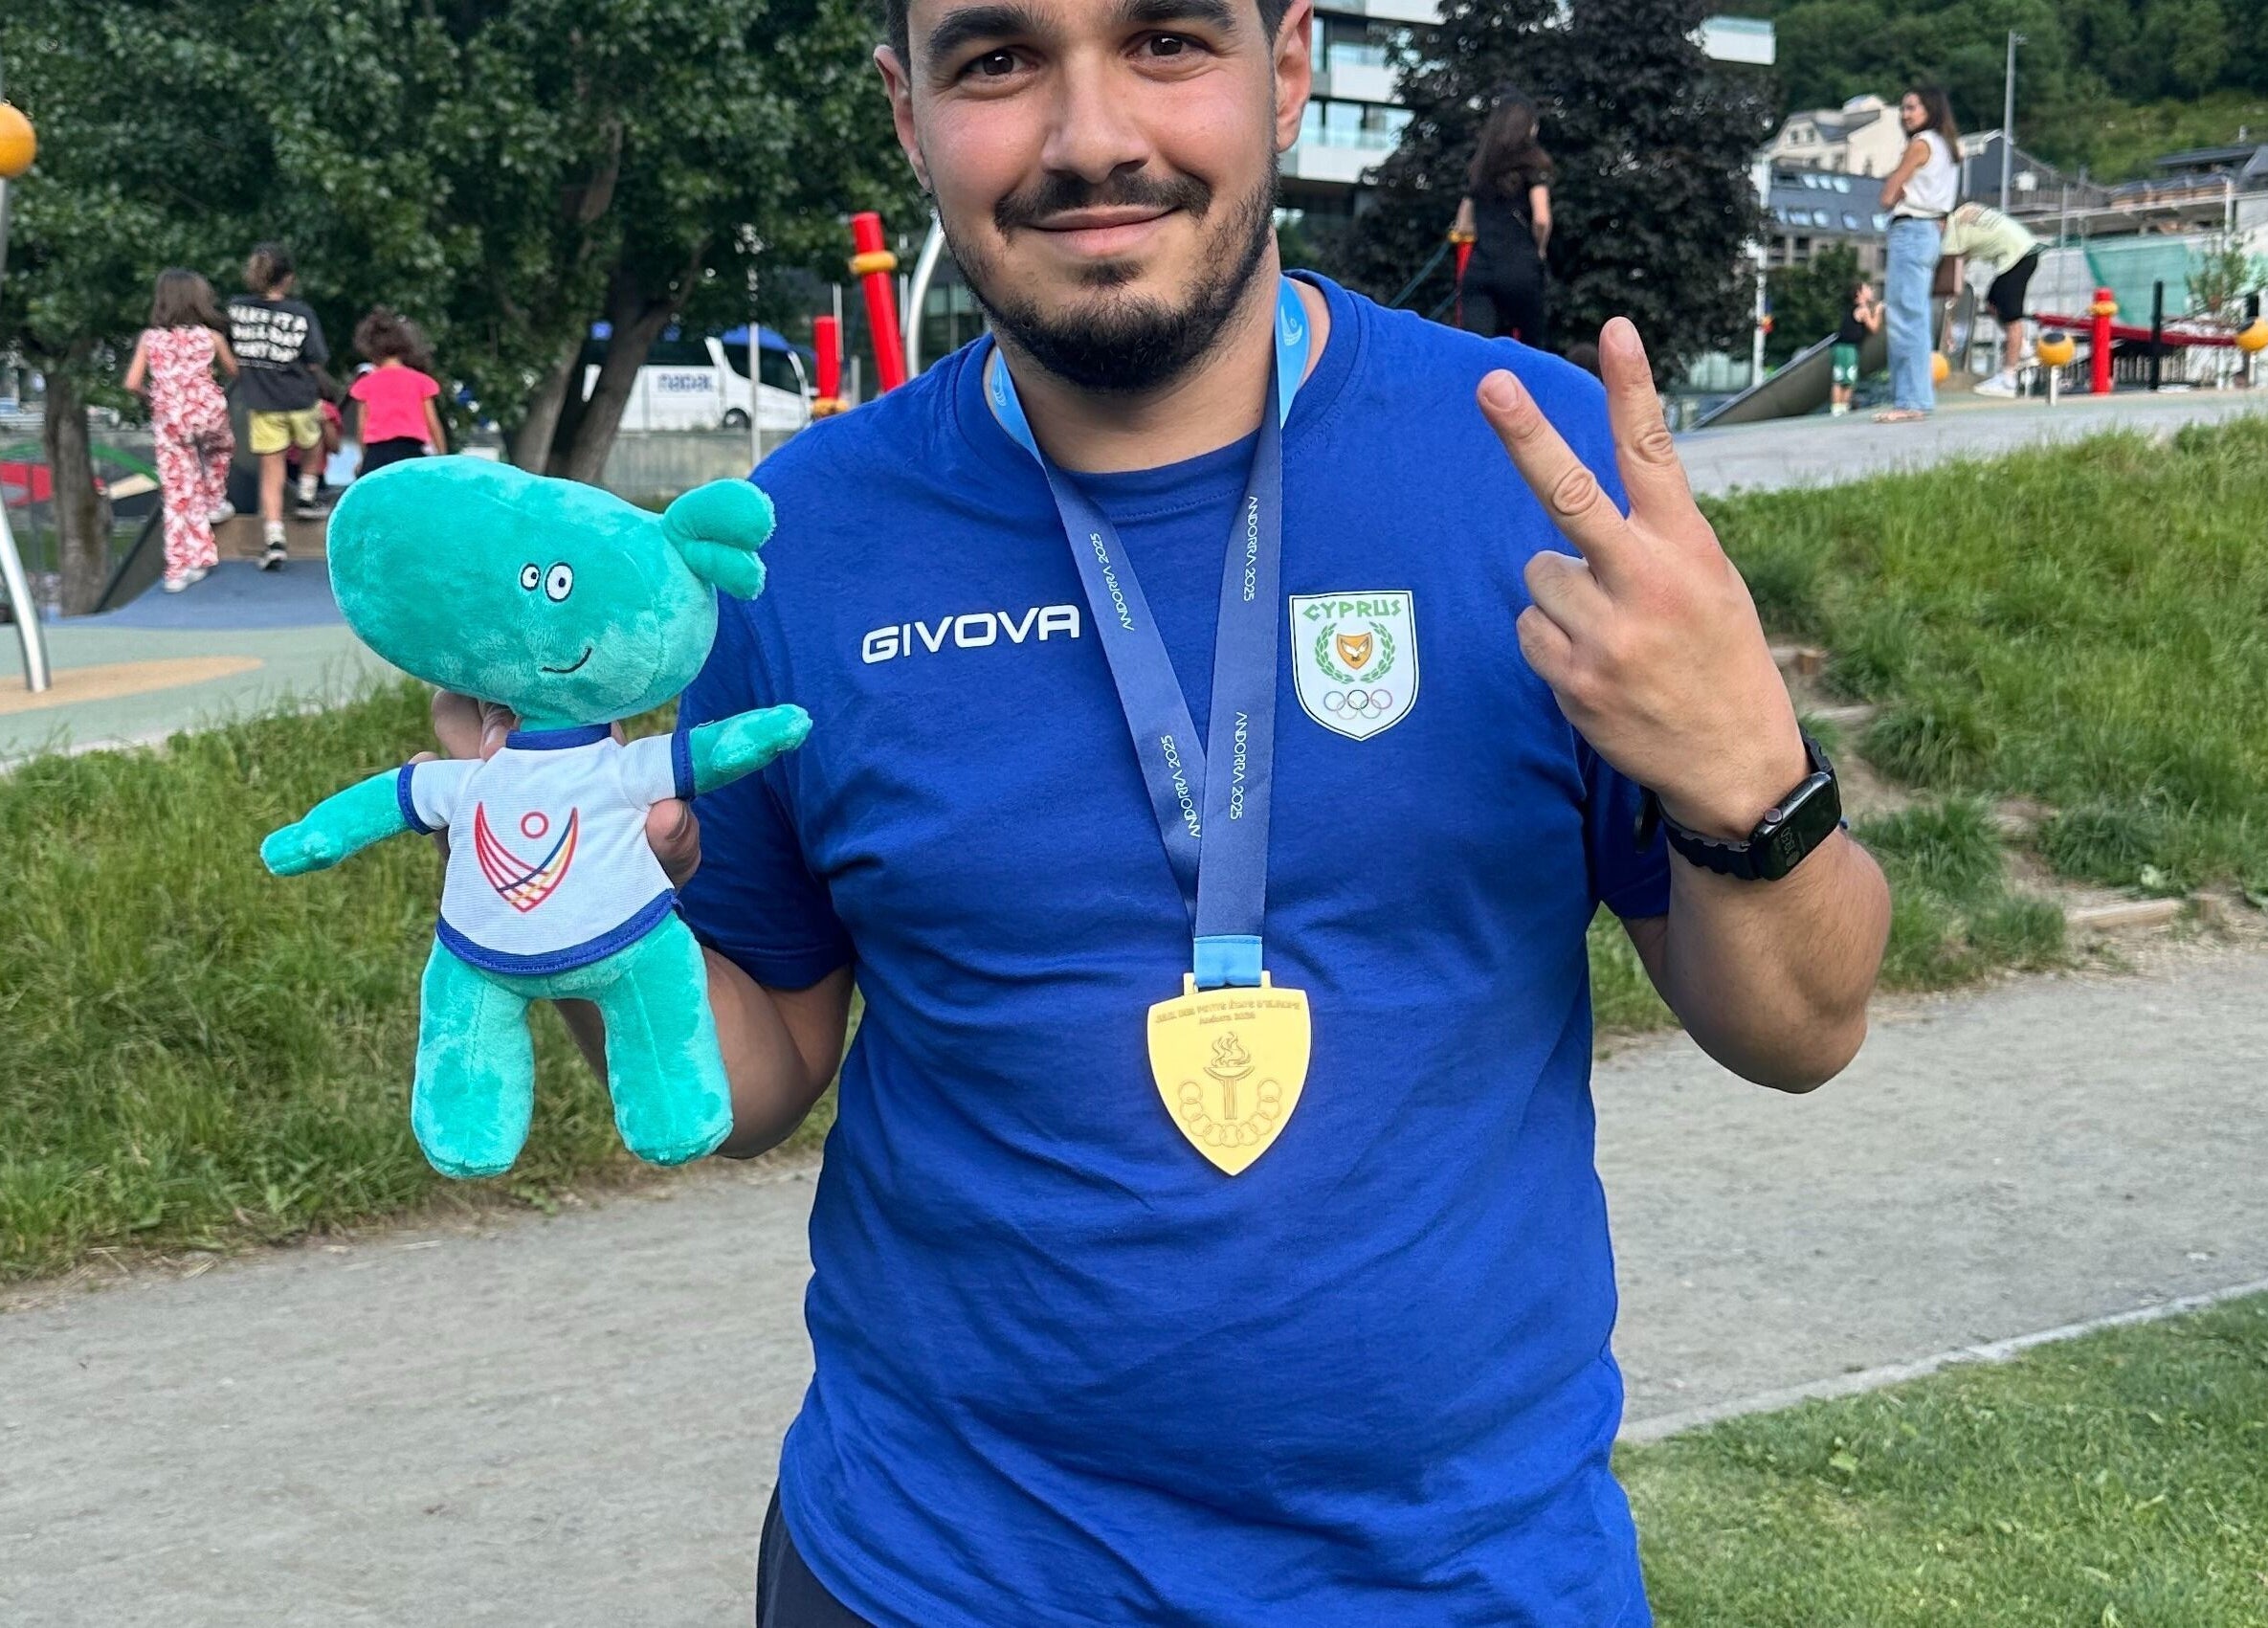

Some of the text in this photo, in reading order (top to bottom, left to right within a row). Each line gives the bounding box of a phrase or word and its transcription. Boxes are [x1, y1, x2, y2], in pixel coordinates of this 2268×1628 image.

[1089, 532, 1135, 631] ANDORRA 2025
[1243, 496, 1258, 601] ANDORRA 2025
[862, 604, 1080, 664] GIVOVA
[1302, 599, 1402, 621] CYPRUS
[1160, 734, 1202, 838] ANDORRA 2025
[1230, 711, 1248, 820] ANDORRA 2025
